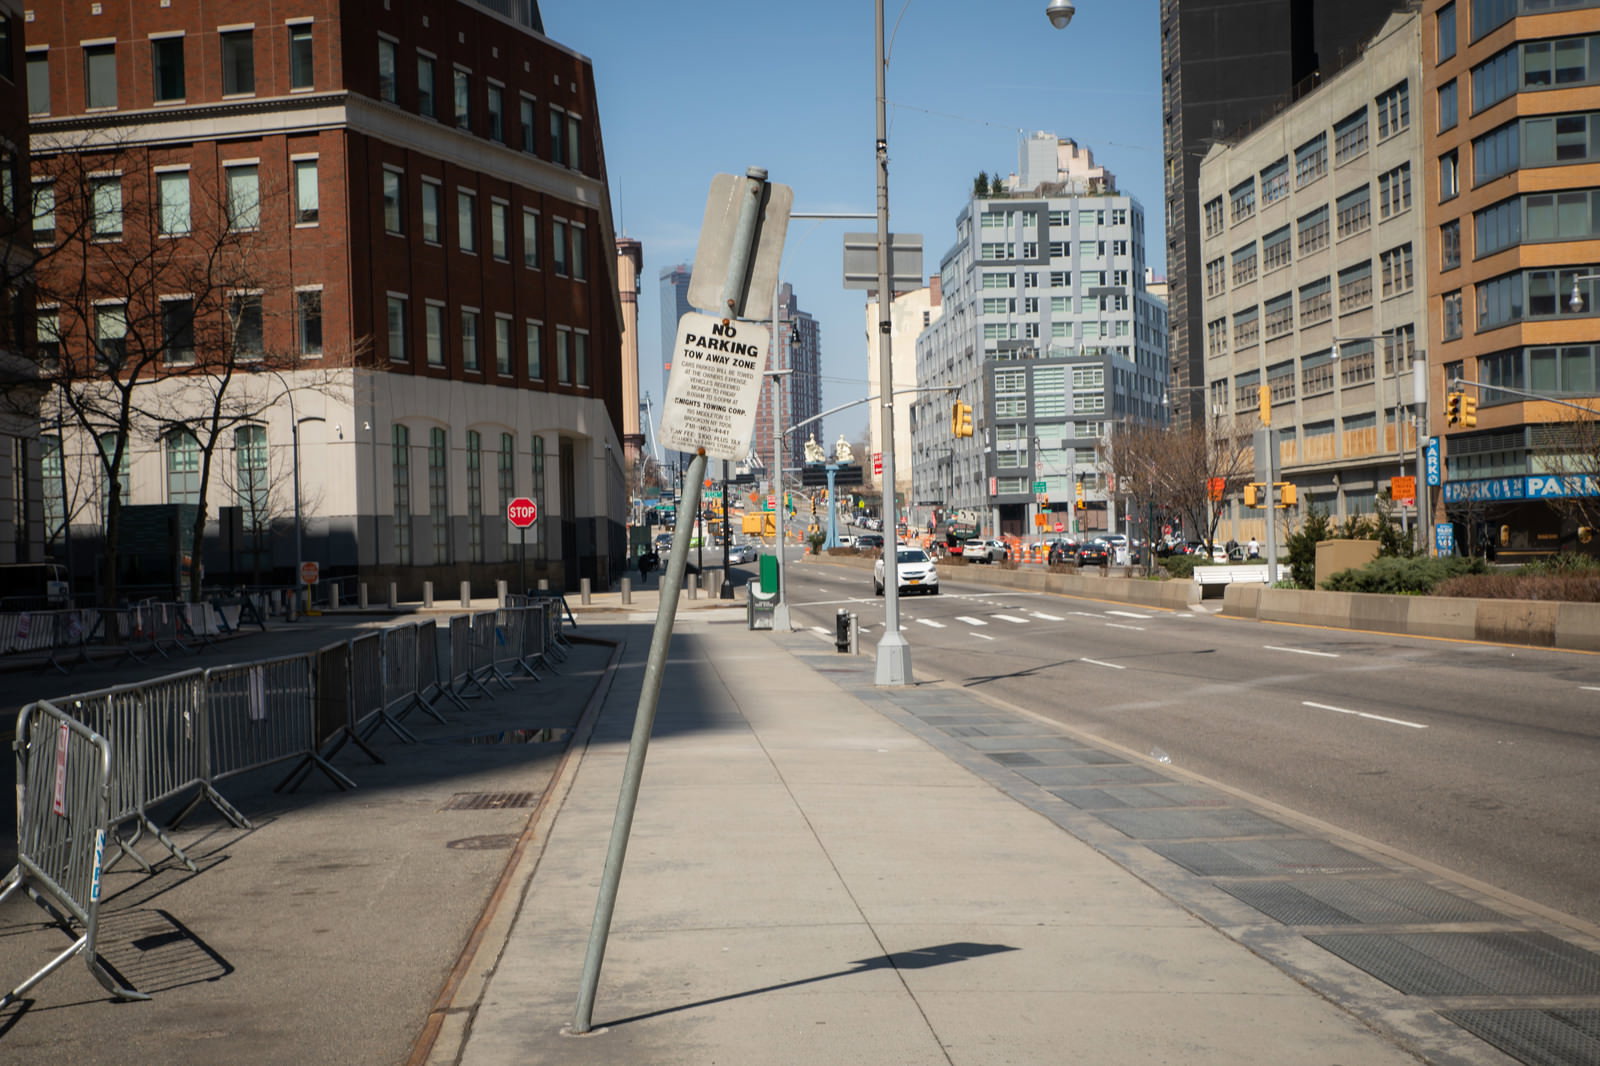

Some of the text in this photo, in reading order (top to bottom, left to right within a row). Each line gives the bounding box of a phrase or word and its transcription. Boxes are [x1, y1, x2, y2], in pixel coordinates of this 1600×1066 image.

[712, 324, 737, 338] NO
[685, 333, 758, 358] PARKING
[684, 349, 756, 370] TOW AWAY ZONE
[703, 402, 727, 413] TOWING
[729, 407, 747, 417] CORP.
[1453, 481, 1492, 499] PARK
[510, 506, 535, 518] STOP
